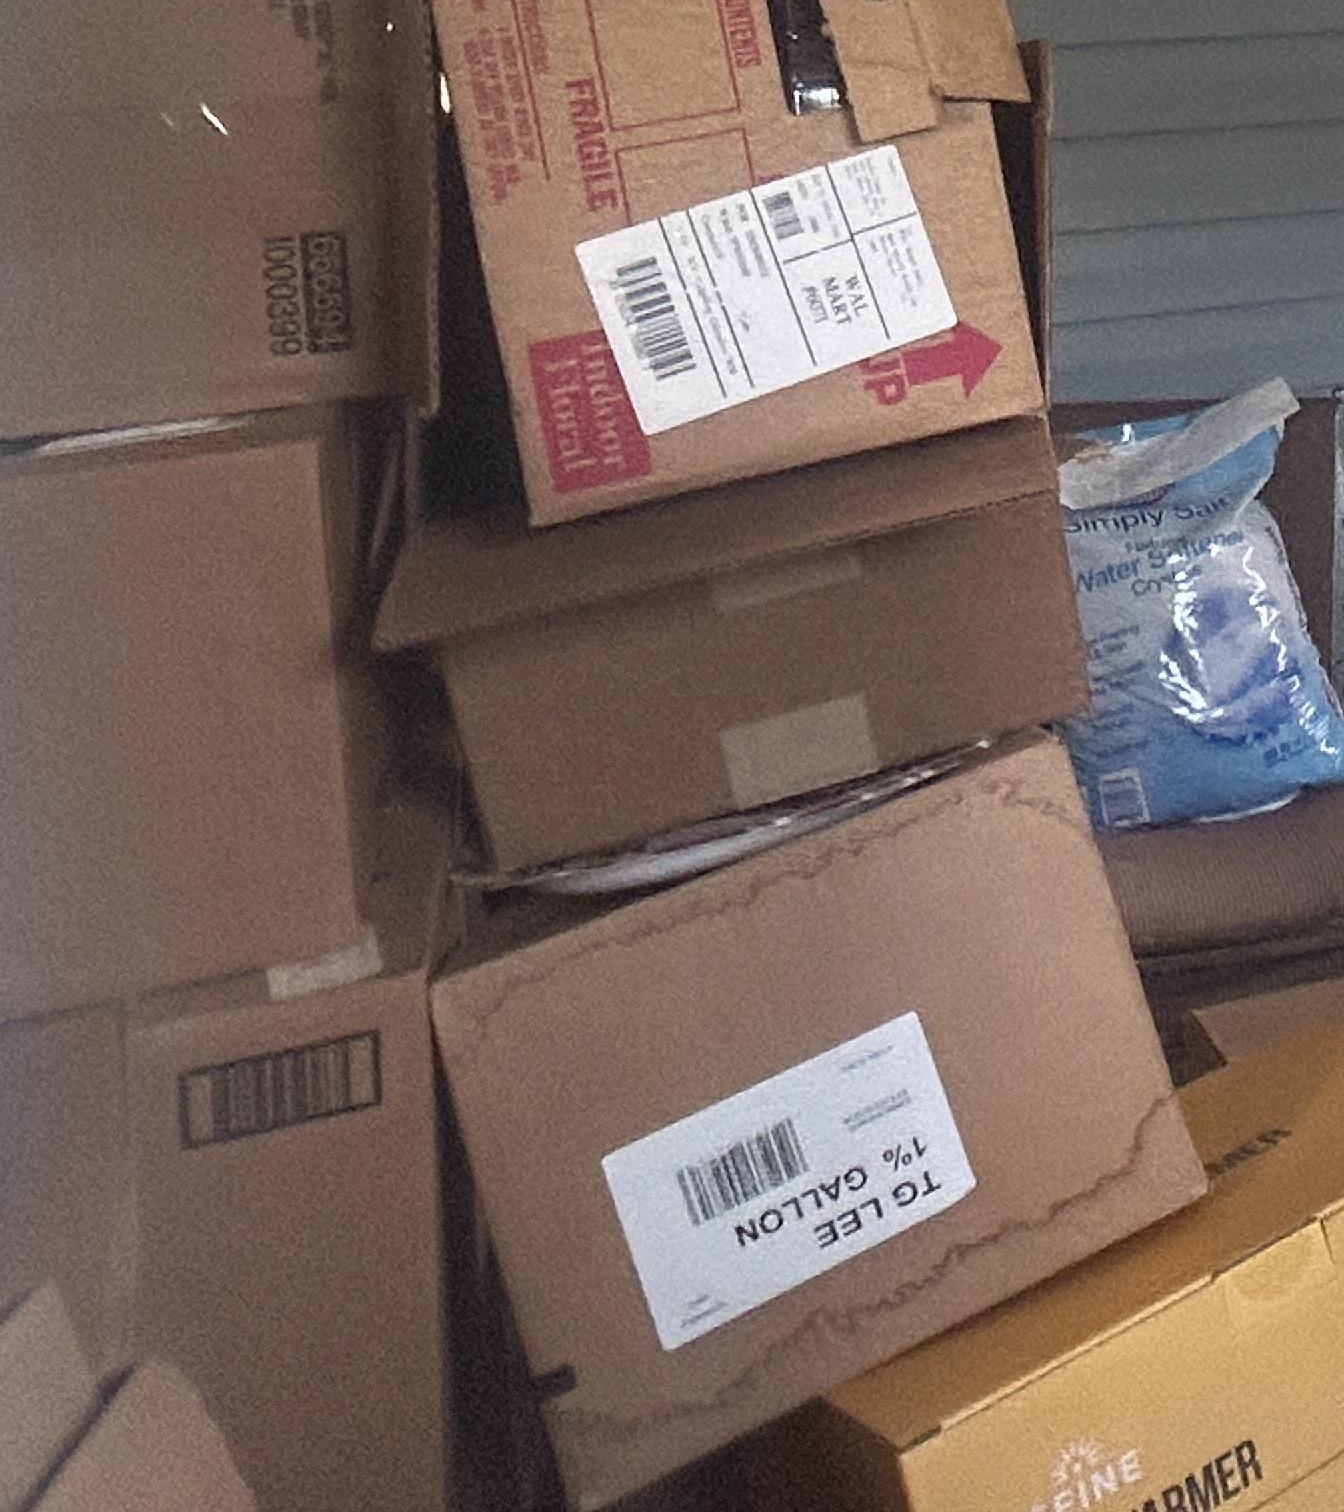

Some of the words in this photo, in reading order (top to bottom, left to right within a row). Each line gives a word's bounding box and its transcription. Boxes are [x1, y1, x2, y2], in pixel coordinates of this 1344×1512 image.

[565, 79, 619, 212] FRAGILE
[262, 236, 302, 355] 1000399
[823, 276, 852, 324] MART
[845, 274, 869, 317] WAL
[882, 1137, 927, 1172] 1%
[734, 1166, 868, 1246] GALLON
[892, 1170, 942, 1207] TG
[814, 1197, 884, 1249] LEE
